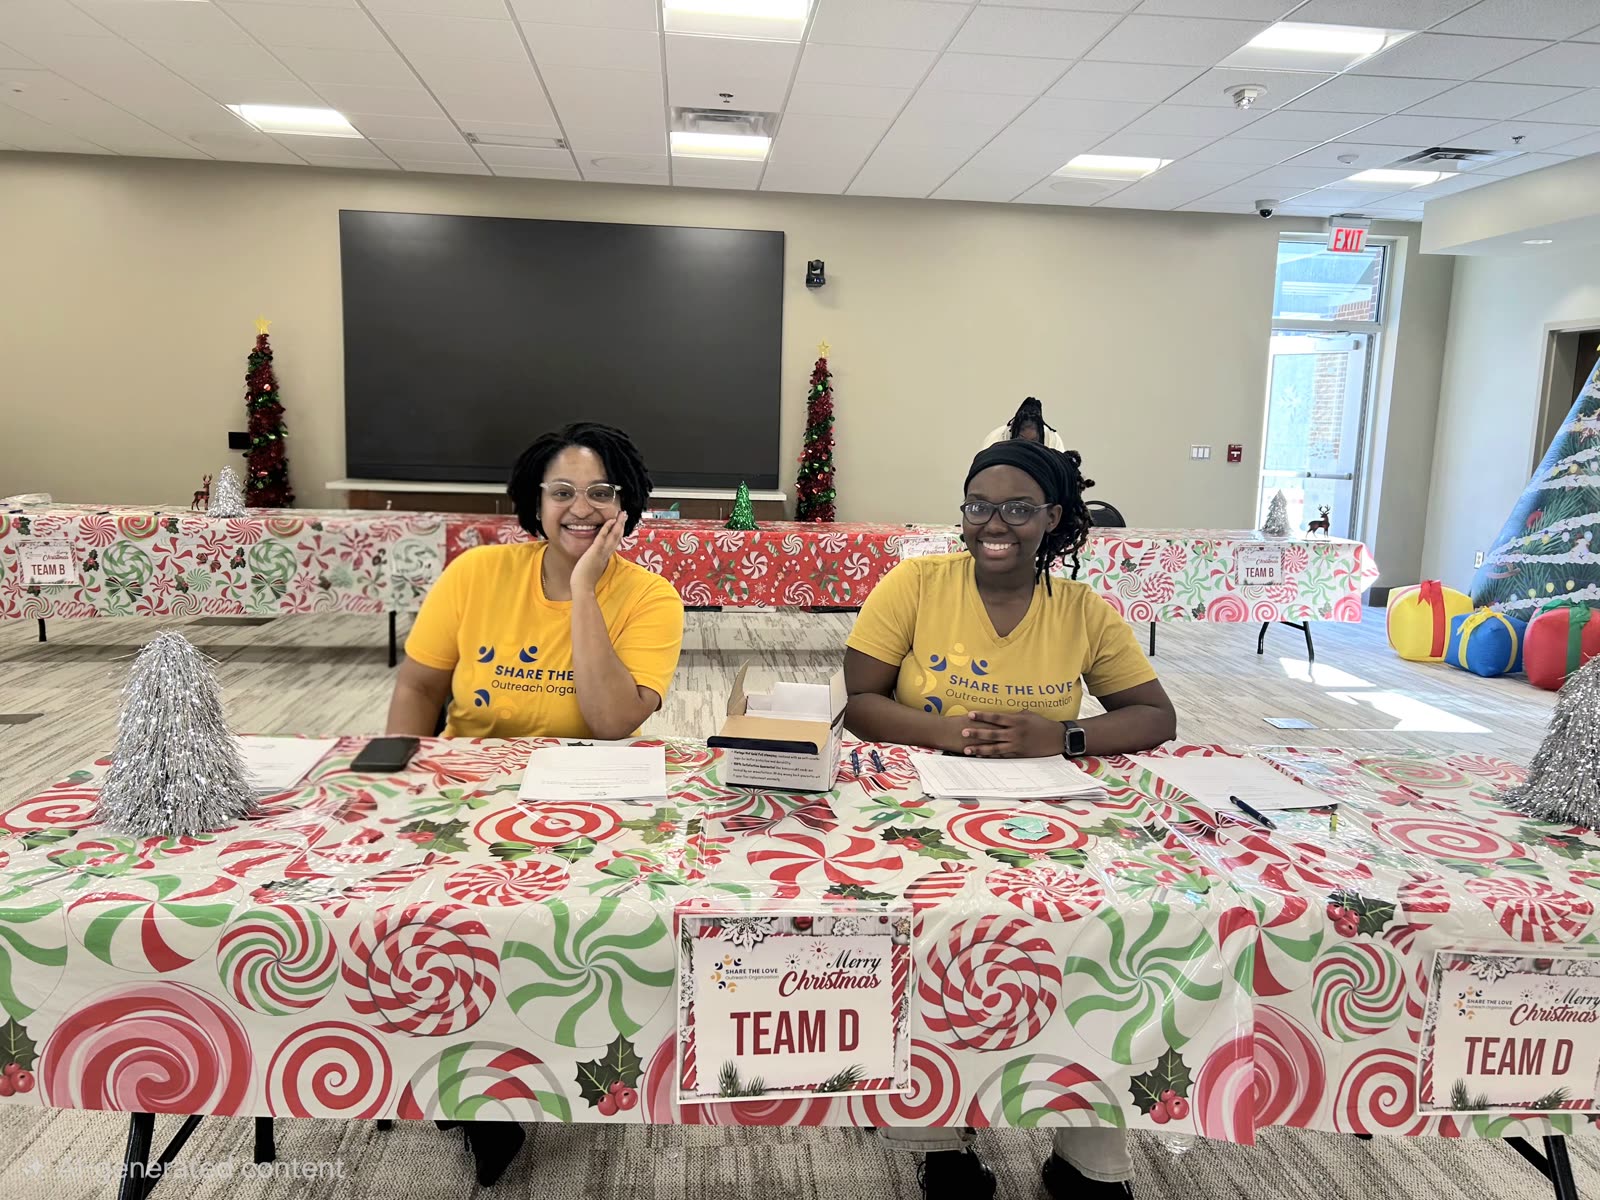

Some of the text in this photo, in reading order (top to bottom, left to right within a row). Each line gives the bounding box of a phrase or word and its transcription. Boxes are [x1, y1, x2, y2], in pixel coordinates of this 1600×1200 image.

[1332, 228, 1364, 252] EXIT
[31, 564, 65, 575] TEAM B
[1245, 567, 1274, 577] TEAM B
[494, 665, 574, 681] SHARE THE
[949, 674, 999, 694] SHARE
[1005, 685, 1034, 695] THE
[491, 679, 543, 693] Outreach
[945, 688, 1073, 710] Outreach Organization
[826, 949, 882, 974] Merry
[778, 968, 882, 998] Christmas
[1555, 987, 1600, 1011] Merry
[1509, 1003, 1600, 1026] Christmas
[730, 1009, 860, 1056] TEAM D
[1464, 1036, 1574, 1076] TEAM D
